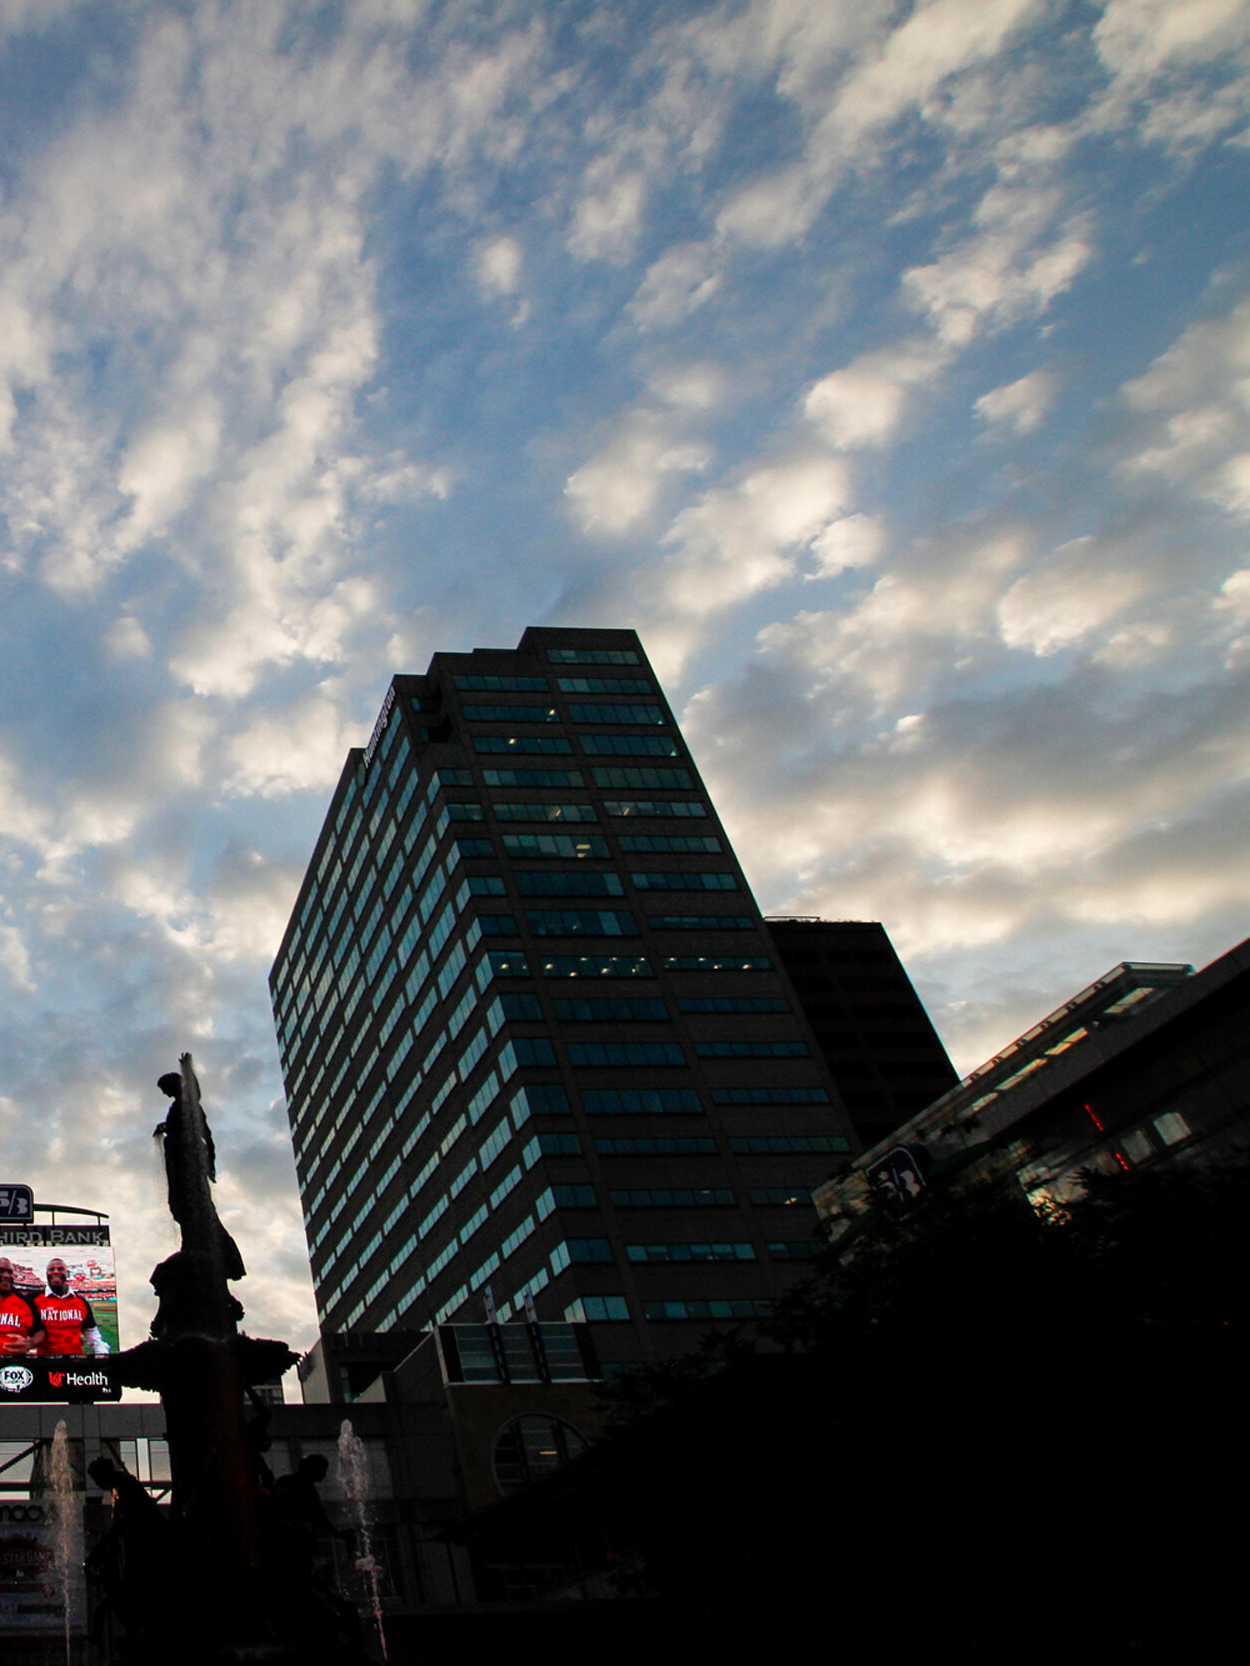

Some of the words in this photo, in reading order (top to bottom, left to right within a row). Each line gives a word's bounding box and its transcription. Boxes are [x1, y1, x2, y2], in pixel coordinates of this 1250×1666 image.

[50, 1229, 104, 1243] BANK
[40, 1308, 83, 1322] NATIONAL
[4, 1370, 25, 1381] FOX
[66, 1371, 109, 1386] Health
